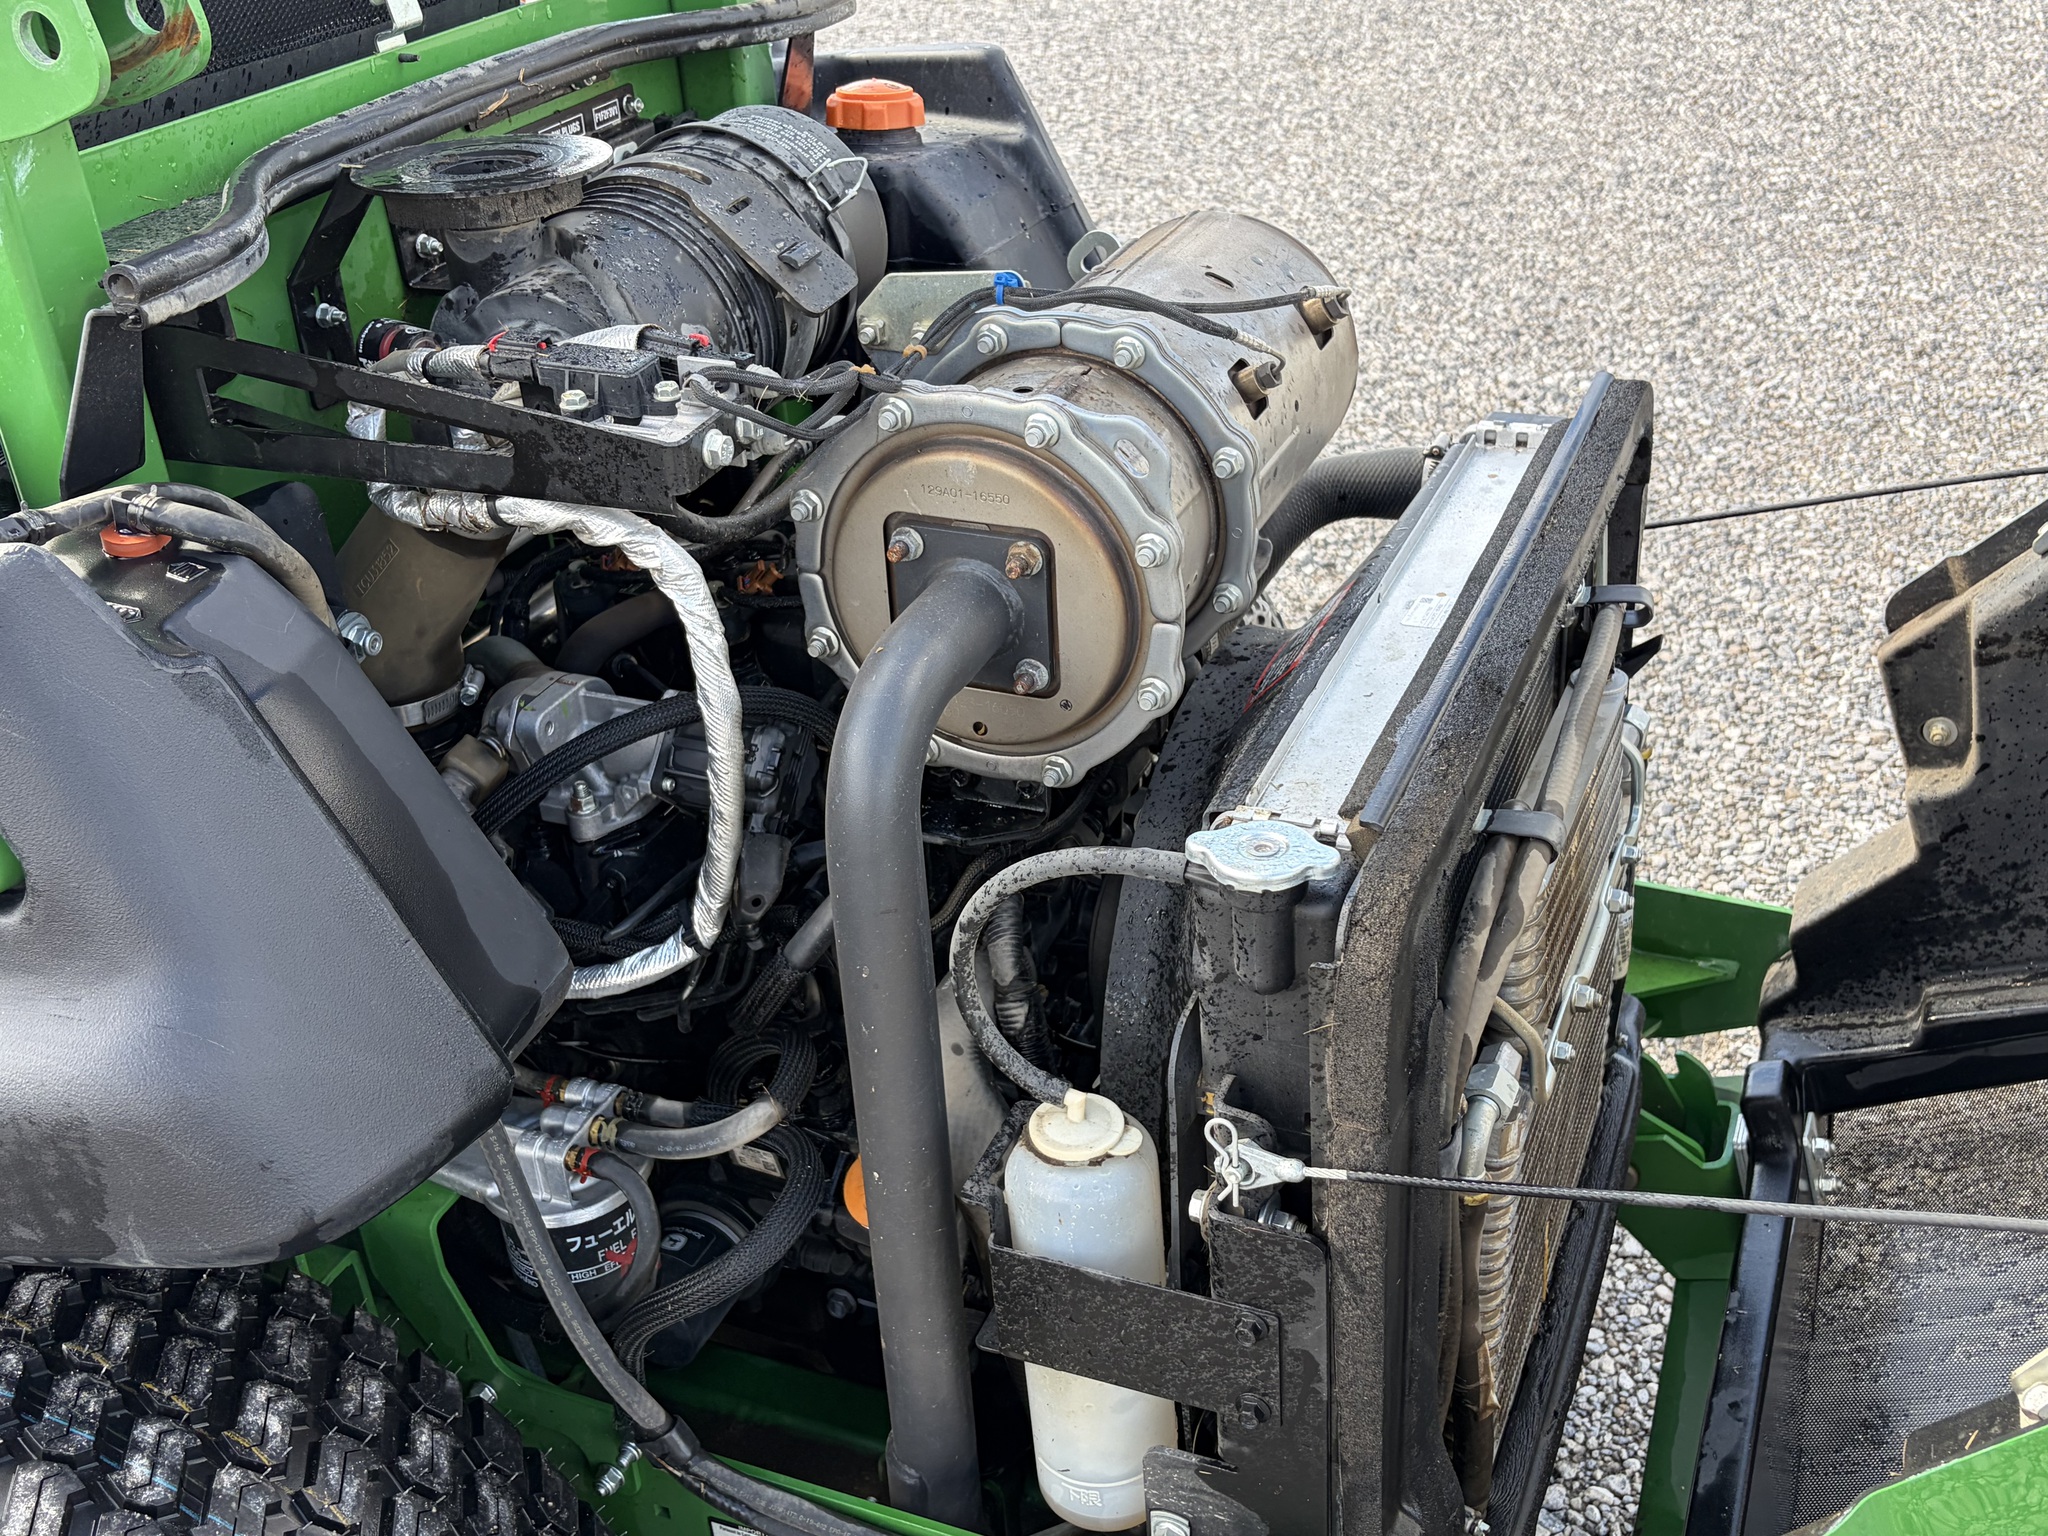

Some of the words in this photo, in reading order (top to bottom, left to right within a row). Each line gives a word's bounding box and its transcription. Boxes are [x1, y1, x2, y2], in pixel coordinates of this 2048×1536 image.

[560, 121, 581, 135] PLUGS
[782, 123, 806, 138] gauge
[784, 128, 794, 136] air
[802, 129, 817, 141] line
[781, 137, 809, 158] prevent
[794, 139, 807, 150] not
[795, 134, 822, 156] Service
[806, 138, 826, 154] when
[817, 140, 830, 151] red
[807, 149, 819, 159] Do
[808, 157, 817, 167] To
[920, 483, 1011, 505] 129A01-16550
[566, 1208, 636, 1253] フューエル
[571, 1269, 597, 1281] HIGH
